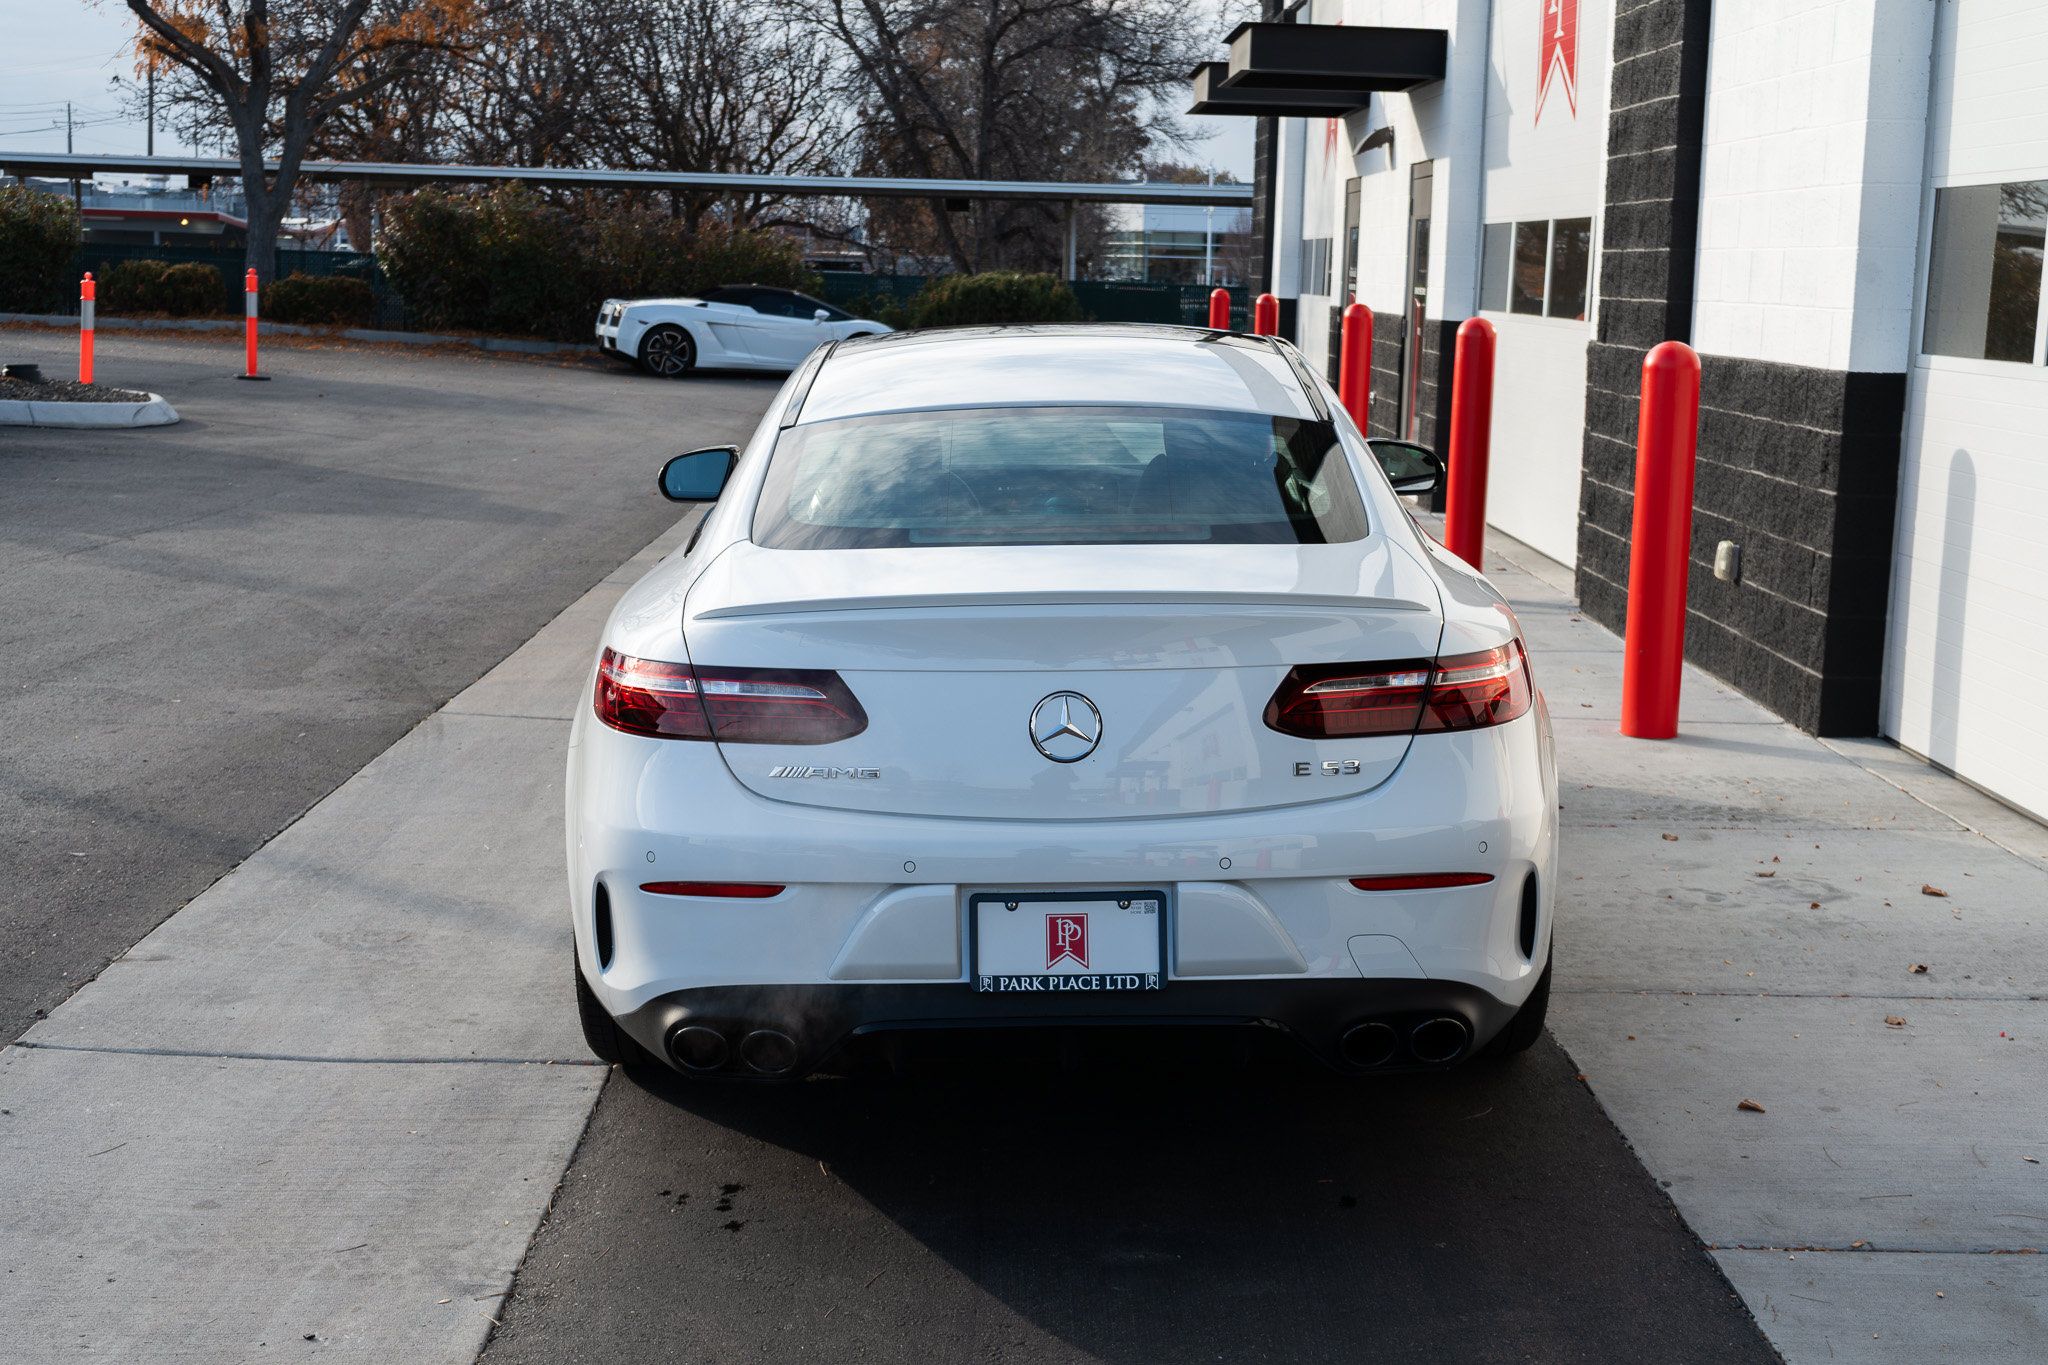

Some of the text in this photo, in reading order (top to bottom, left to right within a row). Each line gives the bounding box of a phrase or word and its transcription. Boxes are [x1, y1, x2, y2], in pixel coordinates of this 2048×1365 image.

[804, 766, 880, 779] AMG
[1293, 760, 1360, 776] E 53
[1000, 975, 1139, 991] PARK PLACE LTD
